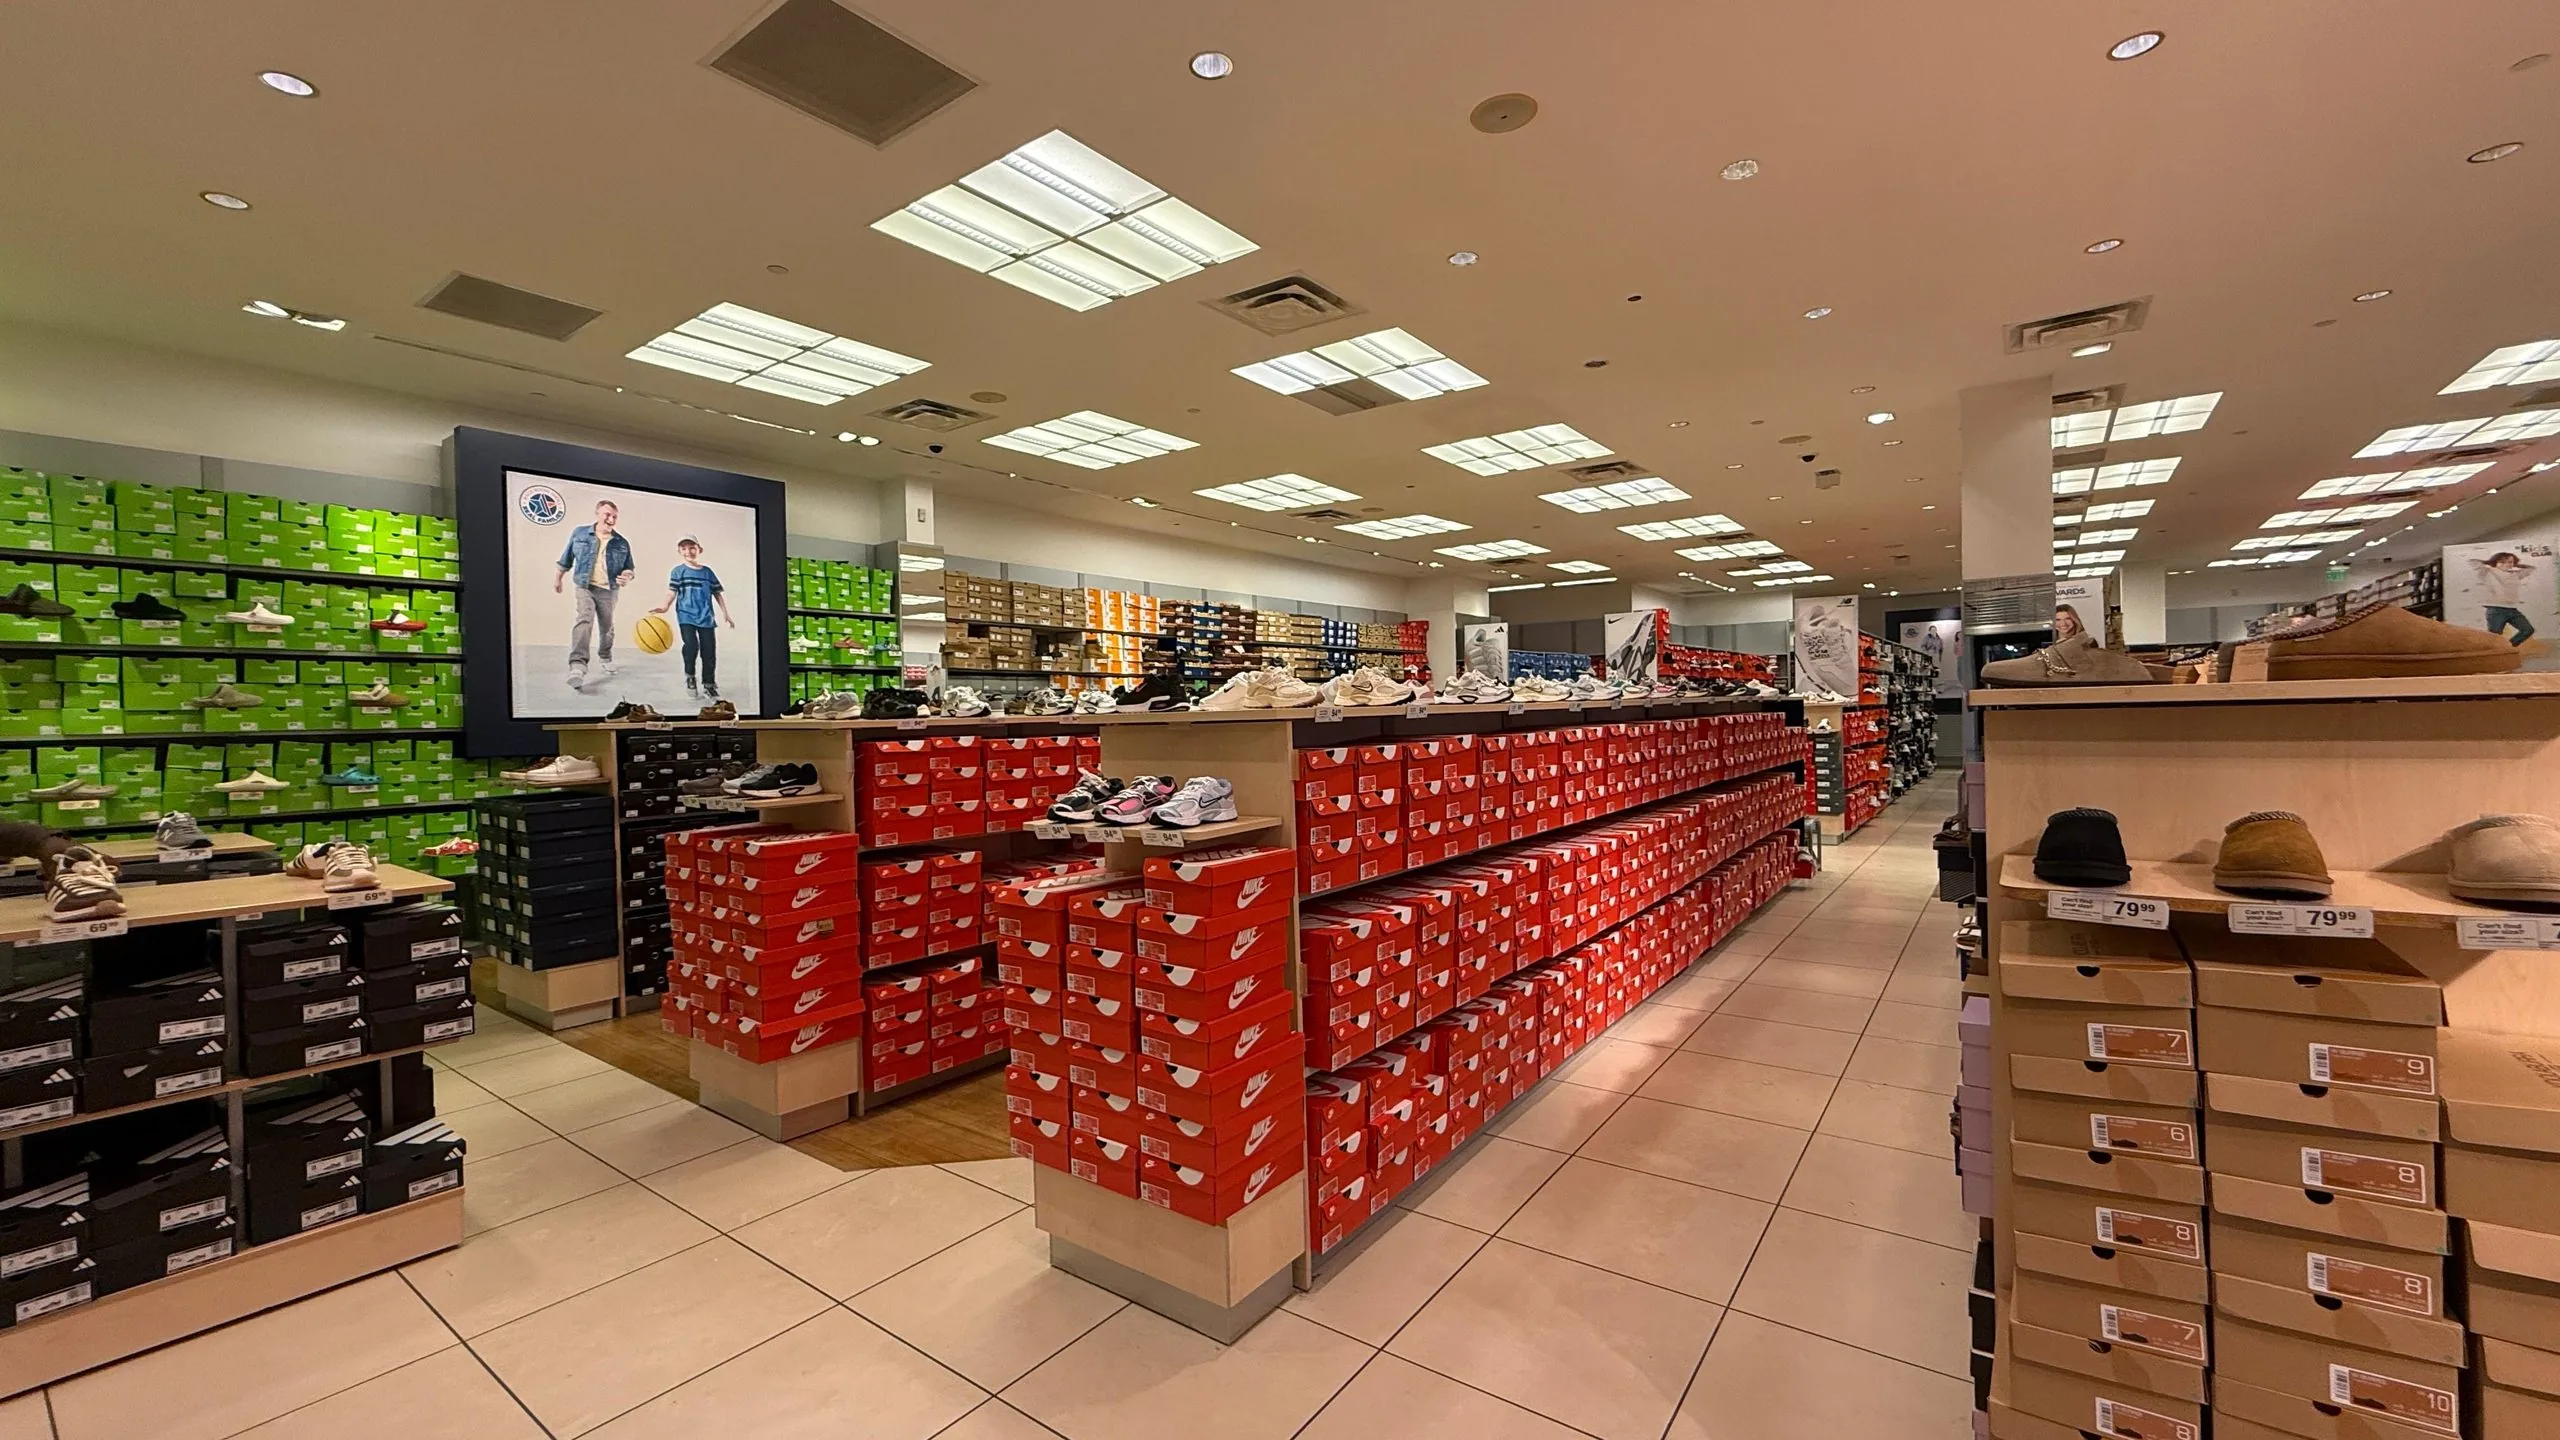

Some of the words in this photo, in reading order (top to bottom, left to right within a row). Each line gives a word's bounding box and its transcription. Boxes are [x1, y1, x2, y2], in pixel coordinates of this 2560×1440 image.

[523, 506, 536, 520] REAL
[1182, 846, 1259, 861] NIKE
[2167, 1033, 2182, 1048] 7
[2407, 1059, 2424, 1075] 9
[2171, 1127, 2185, 1142] 6
[2399, 1166, 2416, 1183] 8
[2176, 1225, 2190, 1240] 8
[2405, 1277, 2422, 1295] 8
[2181, 1325, 2196, 1340] 7
[2427, 1393, 2450, 1412] 10
[2176, 1425, 2190, 1440] 8
